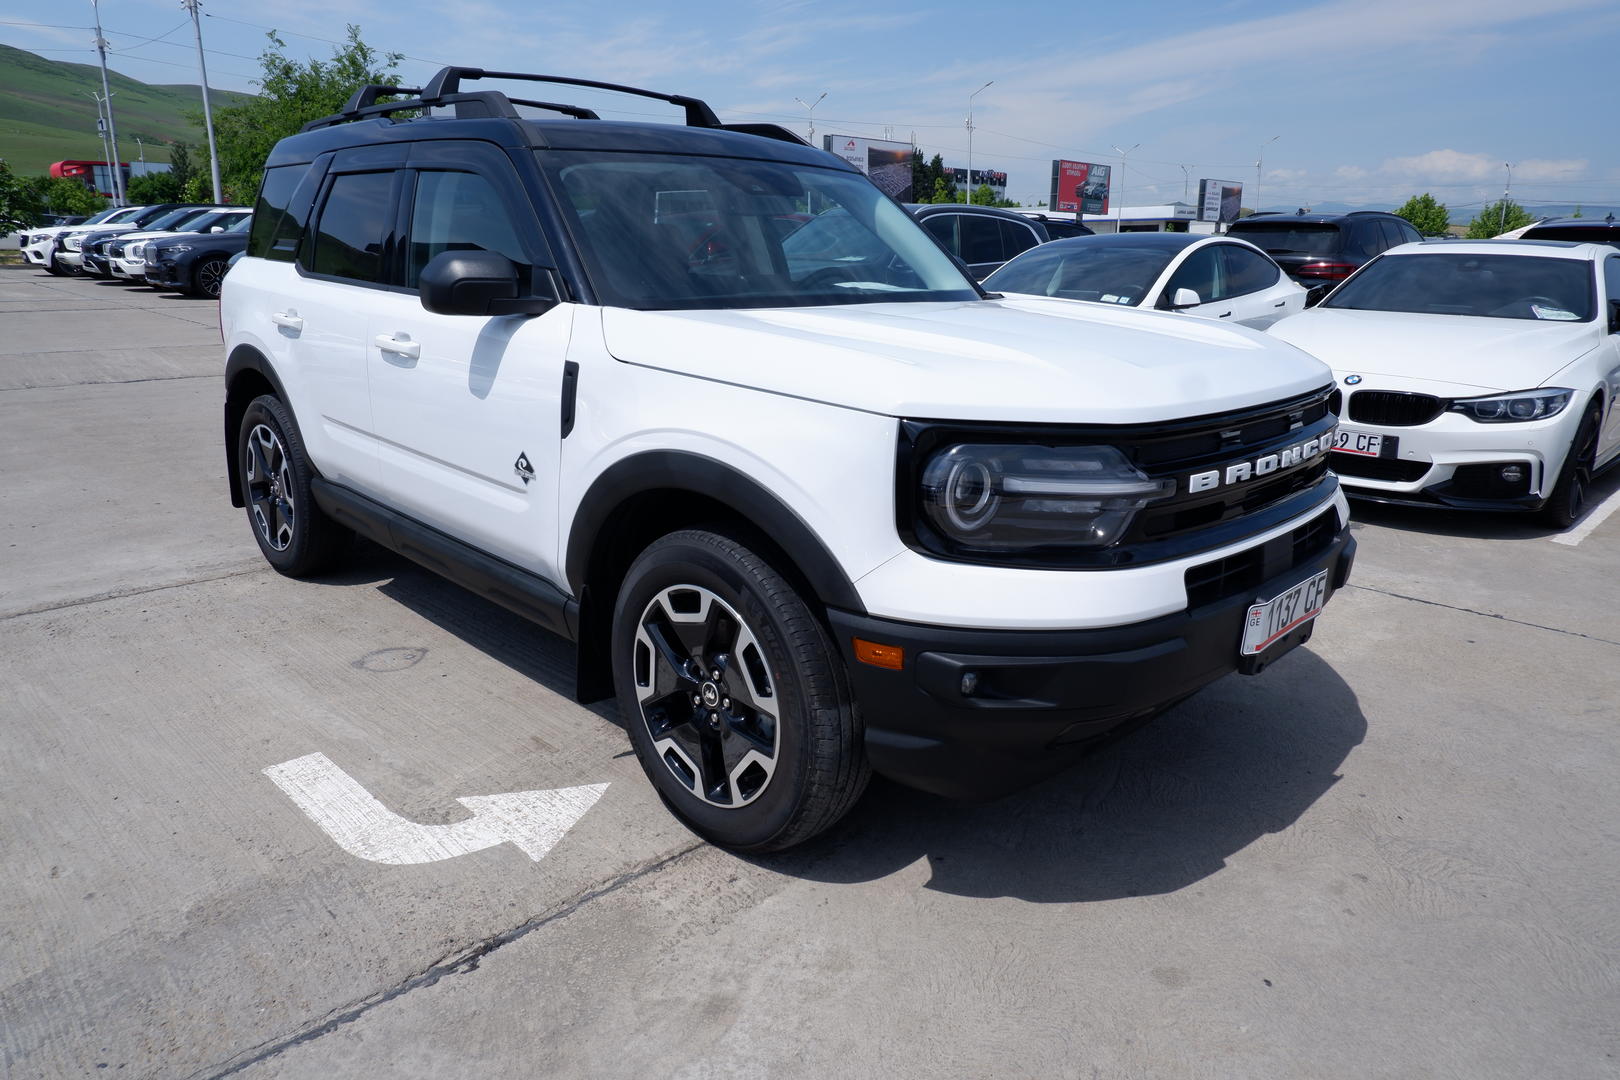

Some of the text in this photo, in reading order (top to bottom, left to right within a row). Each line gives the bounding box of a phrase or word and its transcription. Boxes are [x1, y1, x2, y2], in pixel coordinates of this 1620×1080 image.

[1189, 432, 1333, 494] BRONCO
[1356, 434, 1378, 452] CF
[1249, 618, 1260, 627] GE
[1267, 576, 1326, 638] 1137 CF
